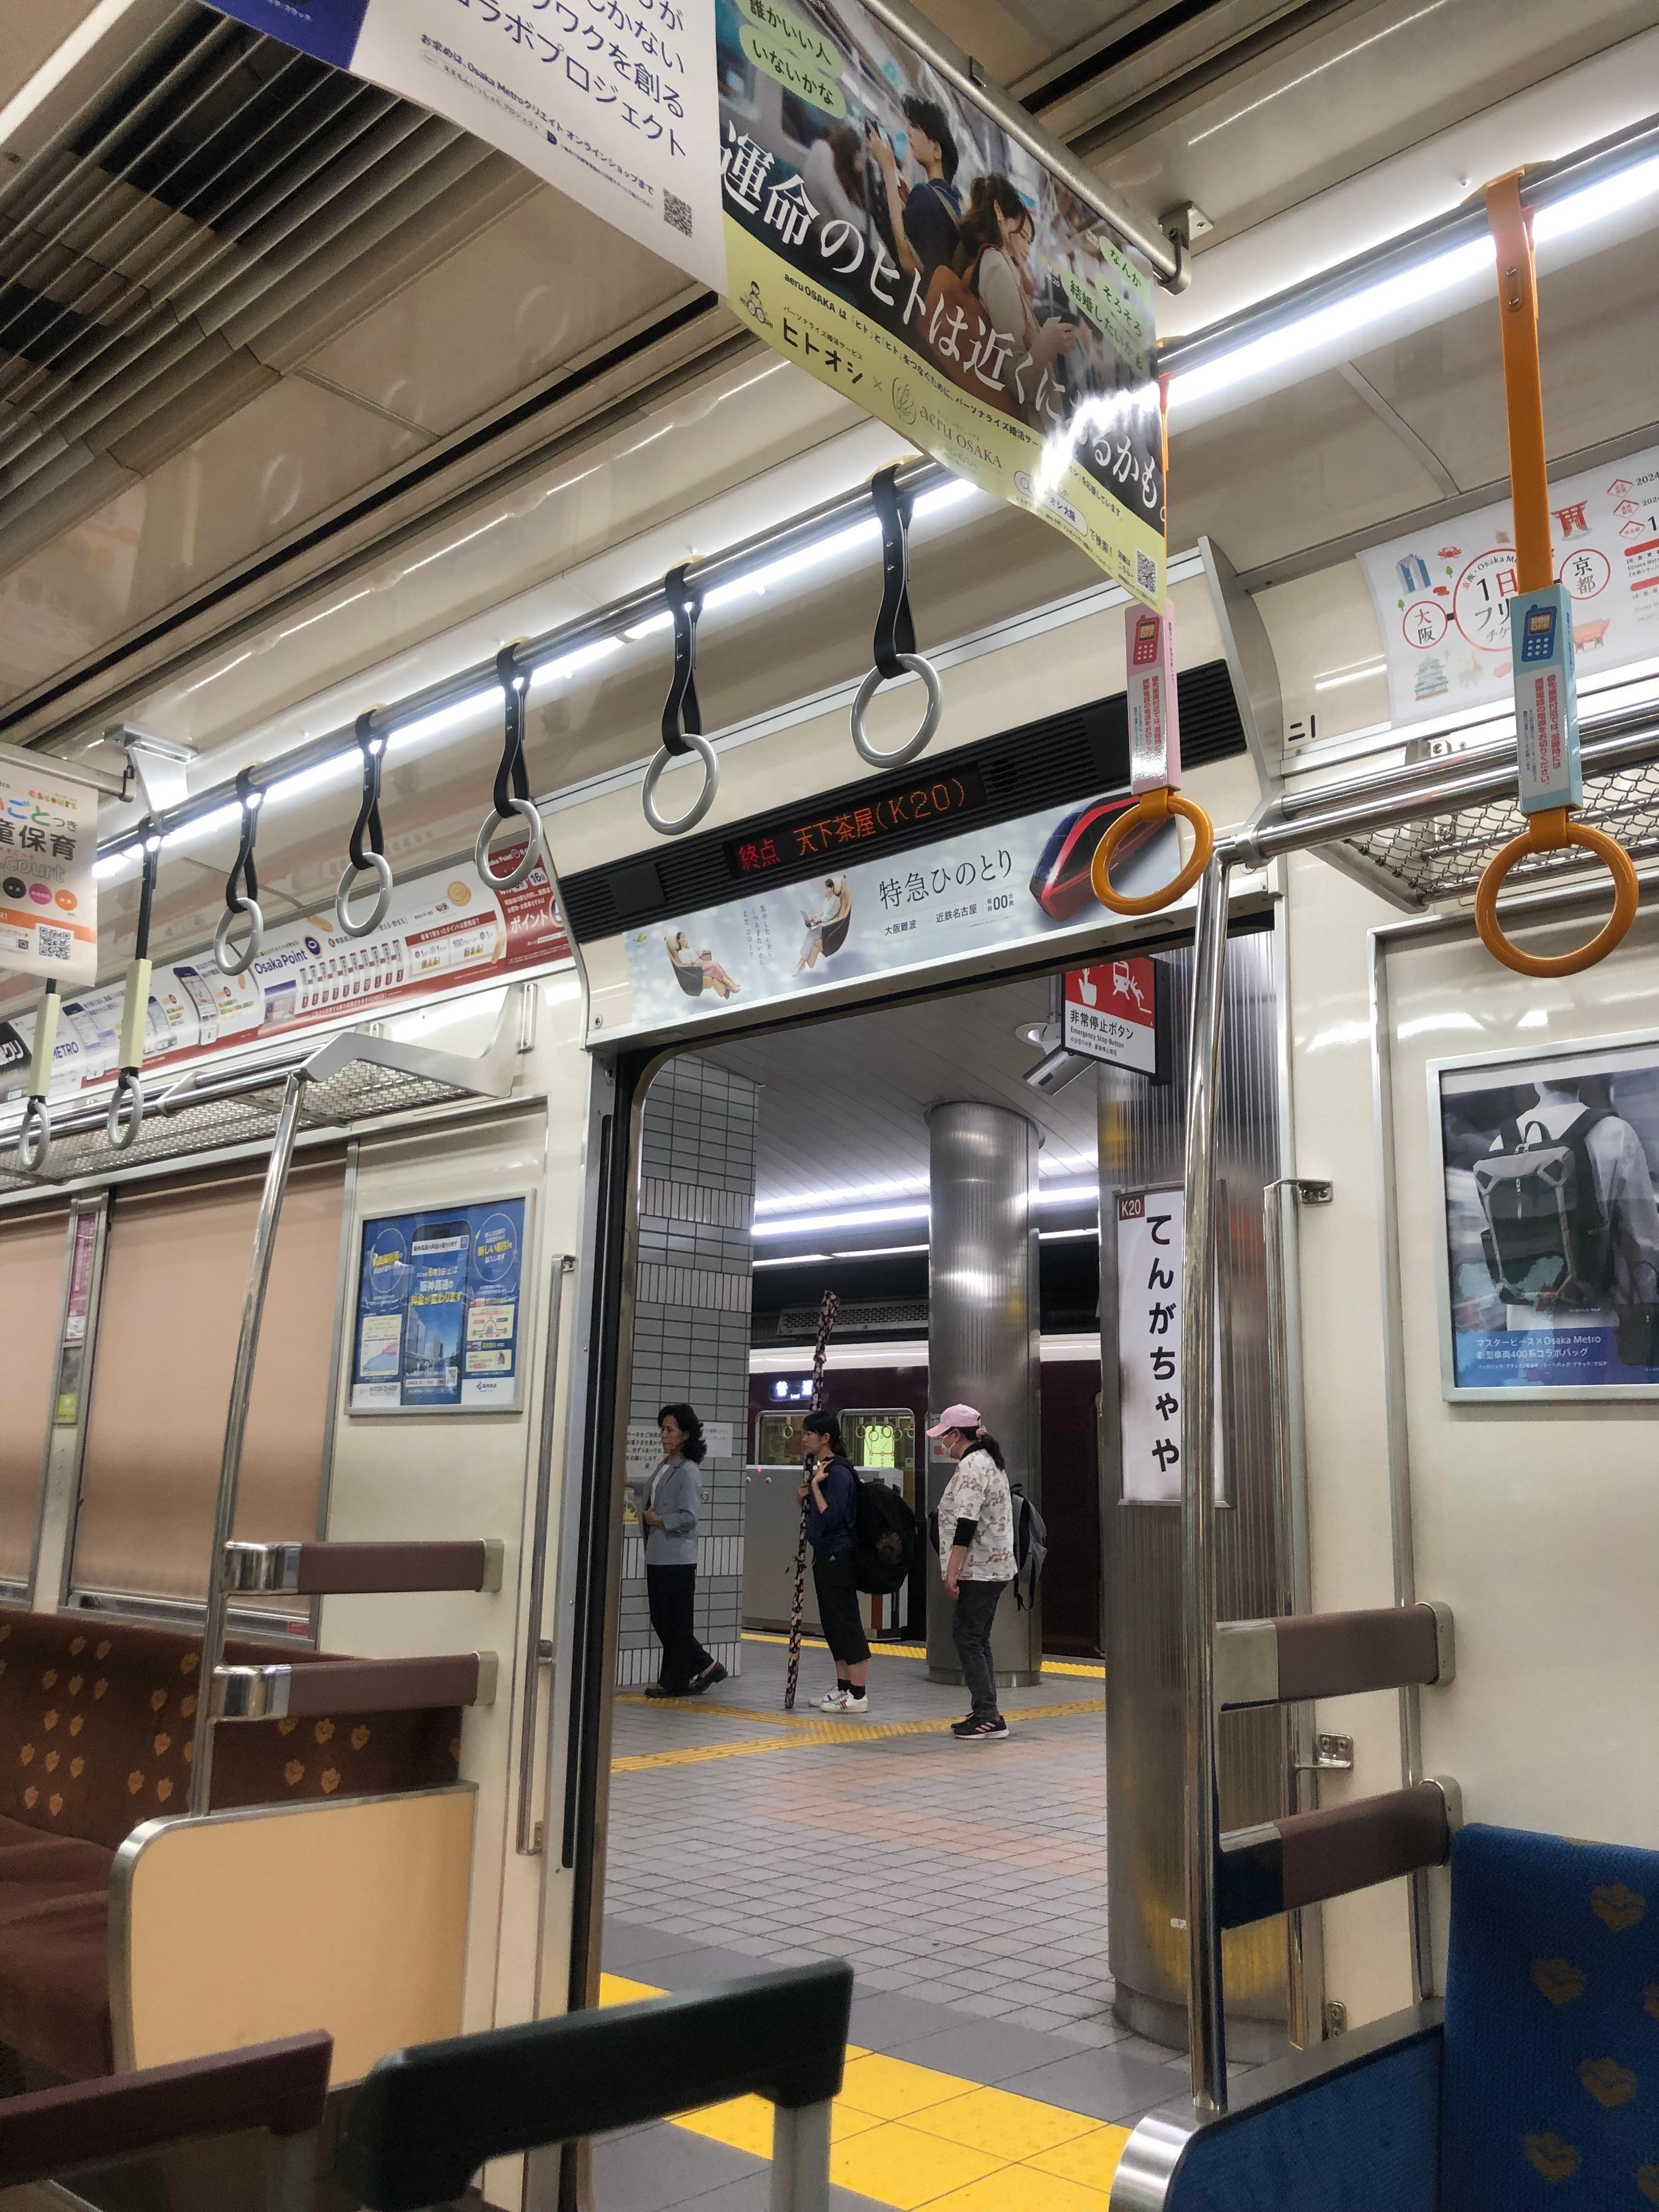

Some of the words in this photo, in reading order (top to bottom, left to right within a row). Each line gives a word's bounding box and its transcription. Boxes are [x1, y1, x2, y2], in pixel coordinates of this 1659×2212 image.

[638, 0, 684, 31] が
[750, 0, 831, 66] 誰かいい人
[455, 0, 686, 156] ラボプロジェクト
[531, 0, 685, 117] ワクを創る
[753, 39, 834, 105] いないかな
[1110, 249, 1142, 287] なんか
[720, 119, 1166, 522] 運命のヒトは近くにるかも。
[1070, 280, 1143, 370] 結婚したいかも
[1103, 285, 1143, 337] そろそろ
[783, 317, 863, 384] ヒトオシ
[919, 406, 952, 440] aeru
[956, 434, 1002, 469] OSAKA
[1572, 556, 1595, 595] 京都
[1415, 608, 1436, 644] 大阪
[738, 838, 781, 871] 終点
[793, 777, 966, 856] 天下茶屋(K20)
[879, 849, 1012, 910] 特急ひのとり
[510, 909, 548, 934] ポイント
[884, 919, 917, 936] 大阪難波
[936, 903, 977, 923] 近鉄名古屋
[1070, 1009, 1133, 1040] 非常停止ボタン
[1070, 1026, 1097, 1041] Emergency
[1097, 1035, 1108, 1045] Stop
[1109, 1038, 1125, 1048] Button
[1121, 1199, 1142, 1216] K20
[1146, 1214, 1180, 1472] てんがちゃや
[1476, 1347, 1589, 1360] 新型車両400系コラボバッグ
[1573, 1335, 1601, 1344] Metro
